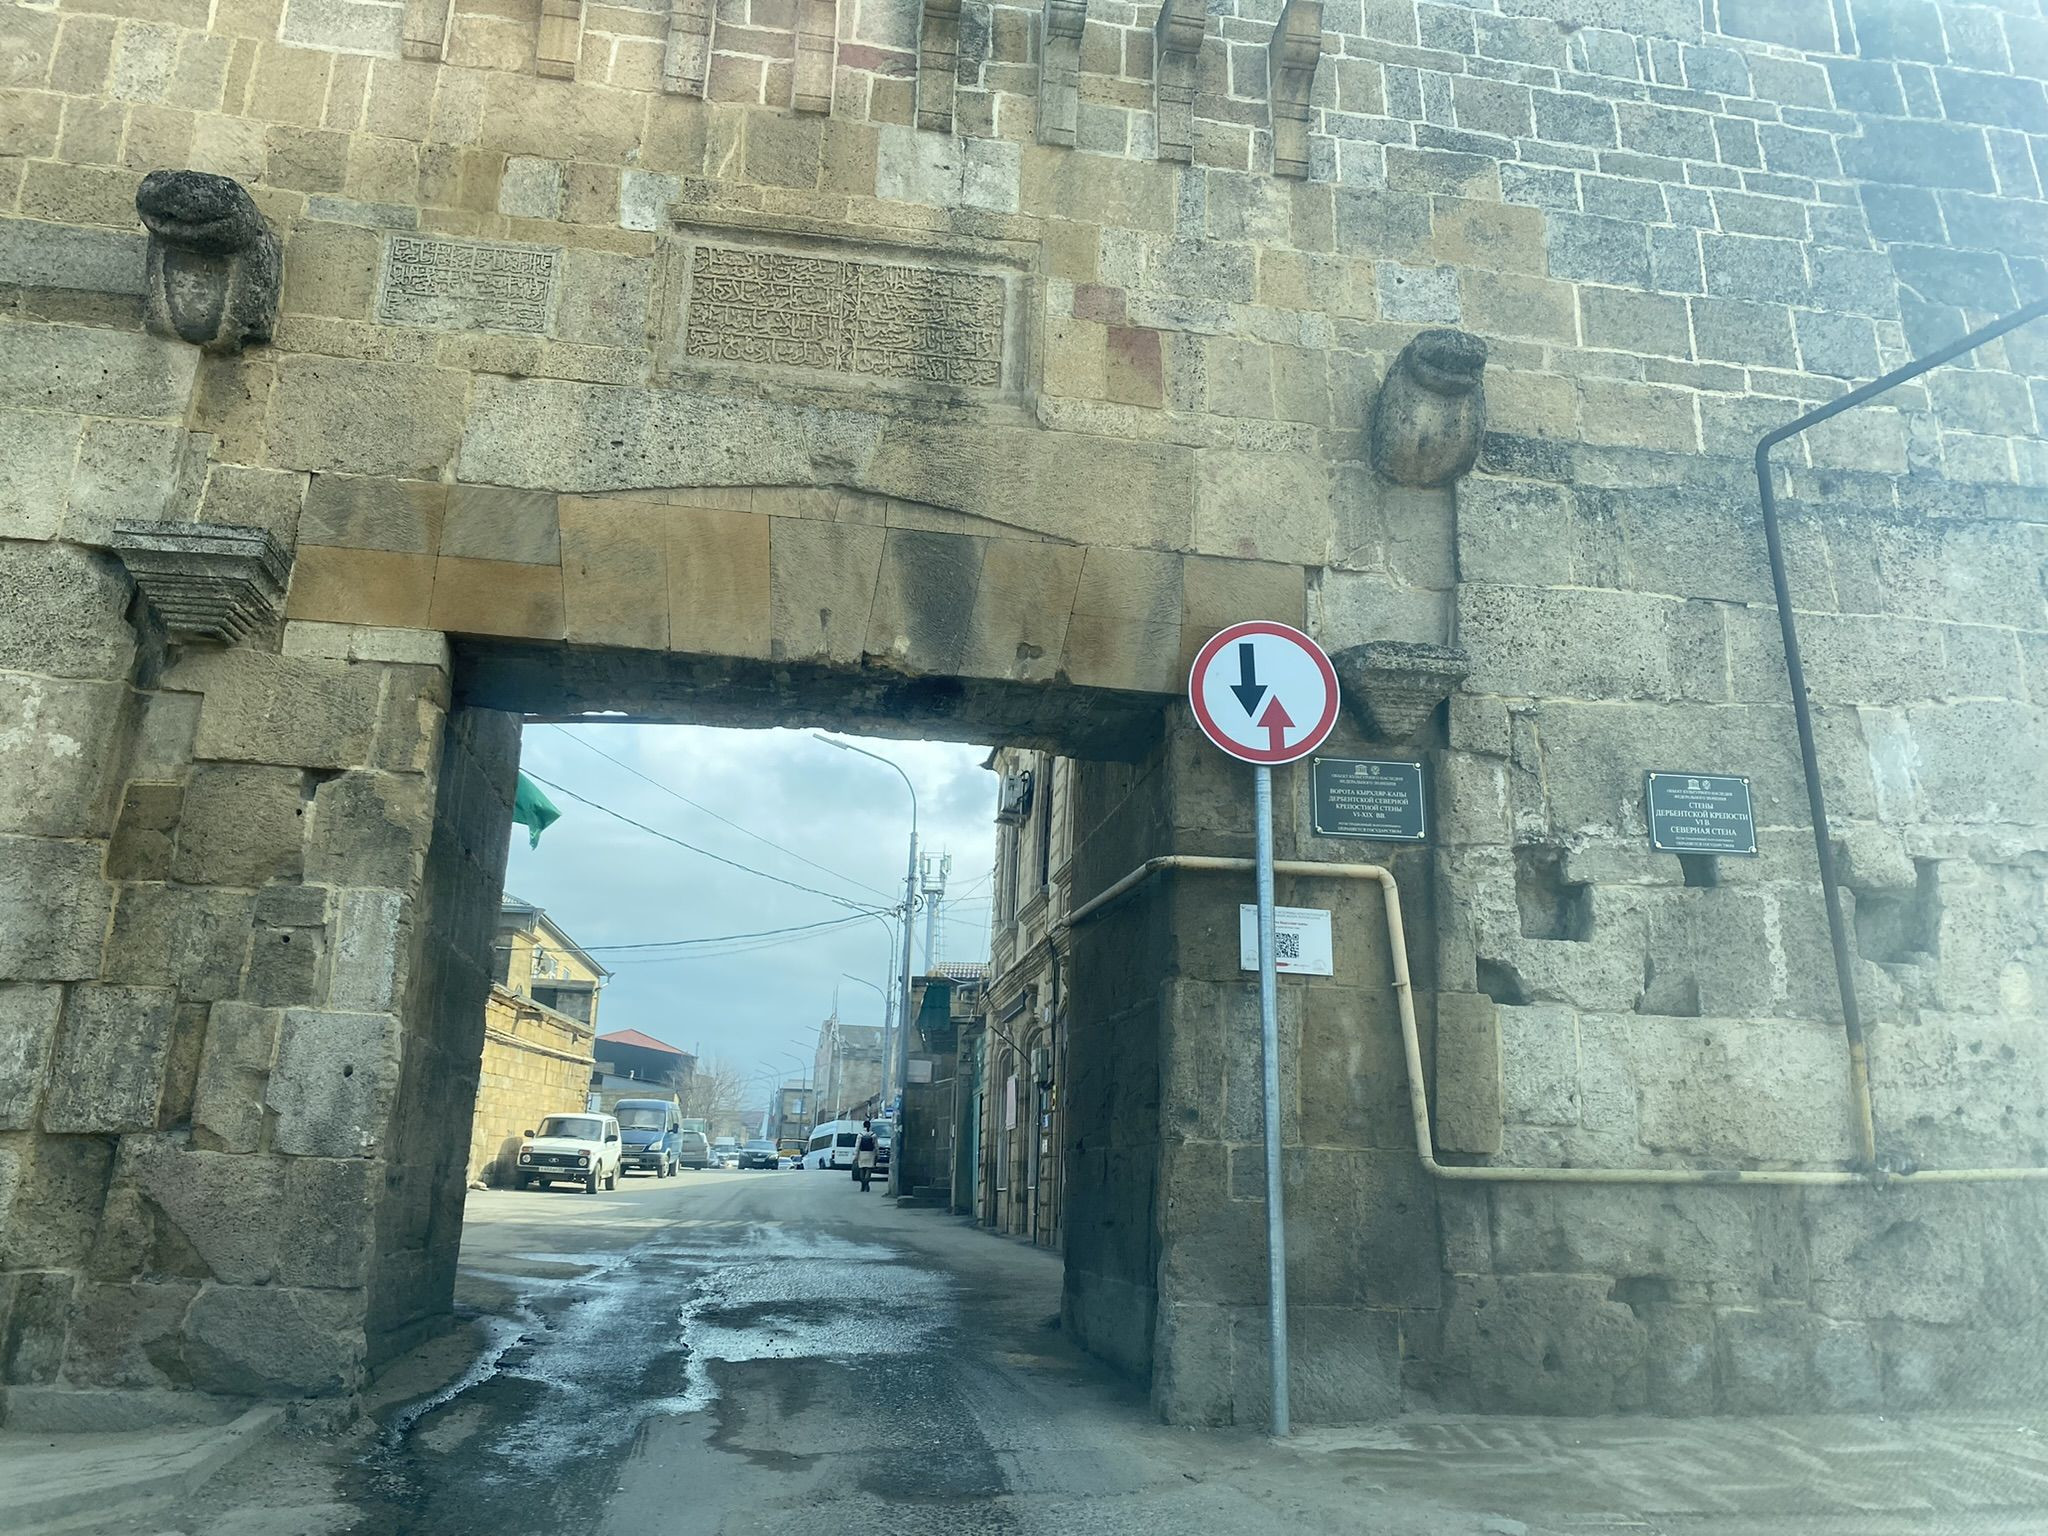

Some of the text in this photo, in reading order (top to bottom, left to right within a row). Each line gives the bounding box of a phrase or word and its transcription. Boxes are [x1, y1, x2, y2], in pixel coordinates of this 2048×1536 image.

[1328, 795, 1374, 803] ДЕРБЕНТСКОЙ
[1335, 803, 1379, 811] КРЕПОСТНОЙ
[1656, 808, 1748, 820] ДЕРБЕНТСКОЙ КРЕПОСТИ
[1695, 818, 1704, 826] VI
[1670, 825, 1737, 835] СЕВЕРНАЯ СТЕНА
